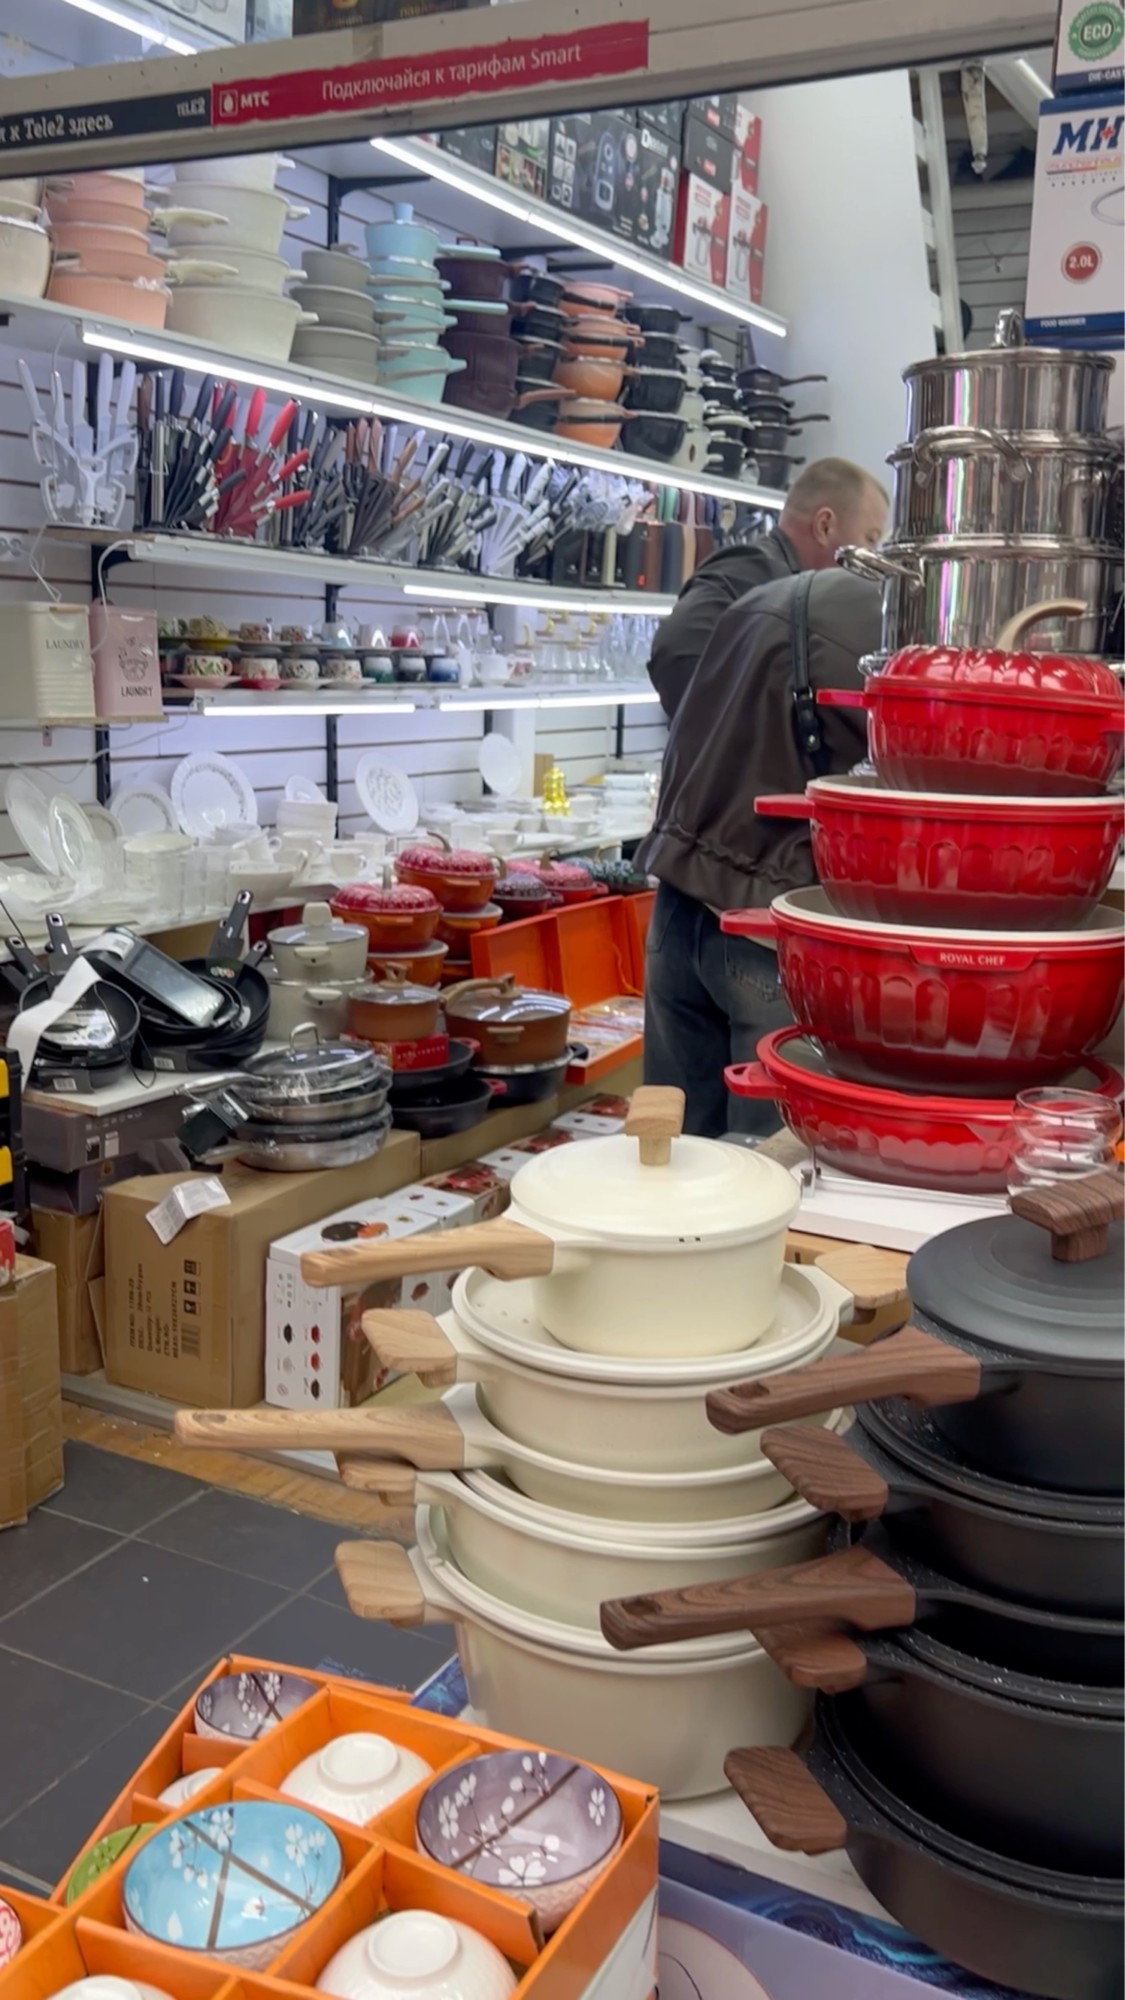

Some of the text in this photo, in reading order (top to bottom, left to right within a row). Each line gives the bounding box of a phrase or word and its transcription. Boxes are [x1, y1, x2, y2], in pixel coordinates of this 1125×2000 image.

[1083, 23, 1112, 41] ECO
[322, 44, 582, 101] Подключайся к тарифам Smart
[241, 91, 269, 108] МТС
[10, 125, 21, 142] к
[23, 114, 65, 140] Tele2
[69, 114, 113, 137] здесь
[1069, 255, 1094, 269] 2.0L
[45, 638, 85, 650] LAUNDRY
[121, 686, 153, 698] LAUNDRY
[940, 952, 1006, 966] ROYAL CHEF
